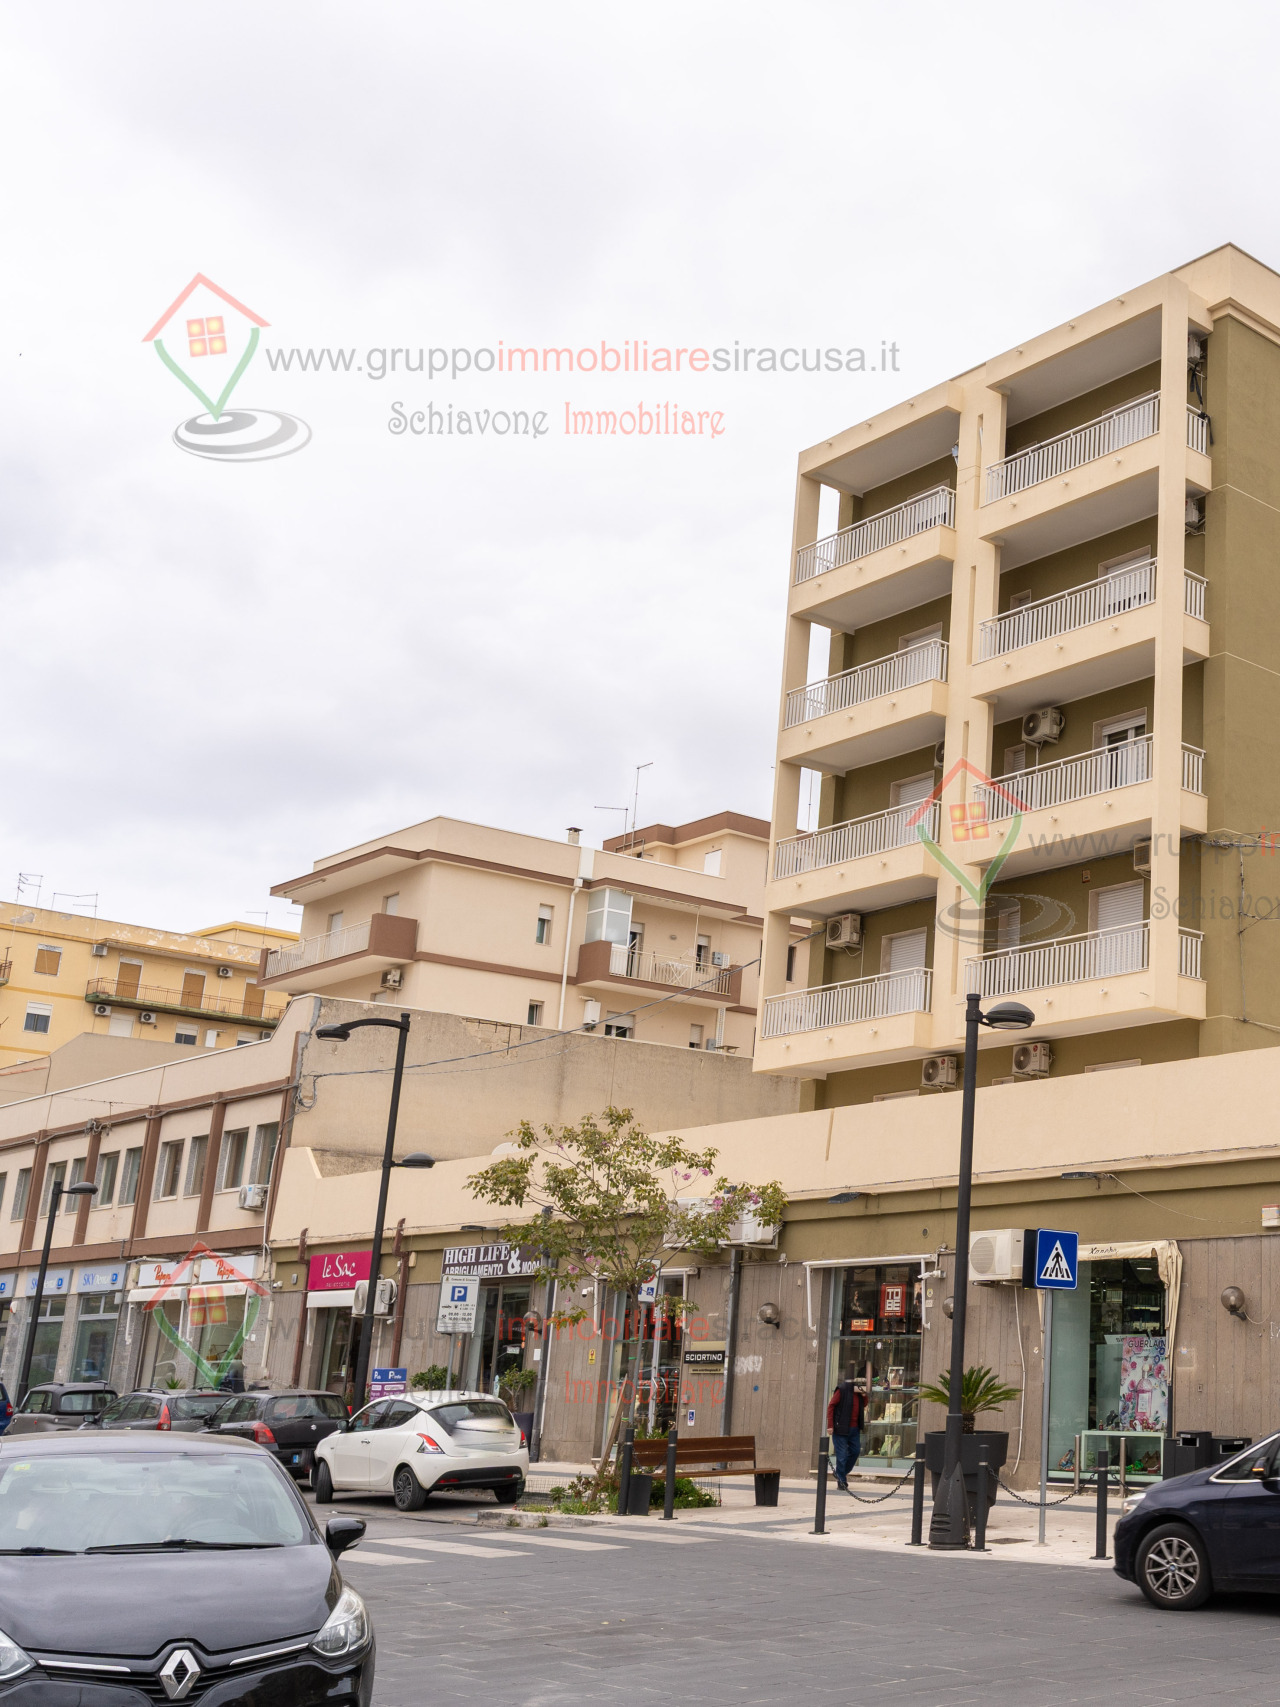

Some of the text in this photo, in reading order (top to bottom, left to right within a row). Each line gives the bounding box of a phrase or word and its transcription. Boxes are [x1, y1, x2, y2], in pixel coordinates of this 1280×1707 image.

[444, 1245, 521, 1274] HIGH LIFE &
[333, 1254, 357, 1278] Sac
[886, 1288, 901, 1300] TO
[1128, 1339, 1166, 1348] GUERLAIN
[685, 1353, 723, 1361] SCIORTINO
